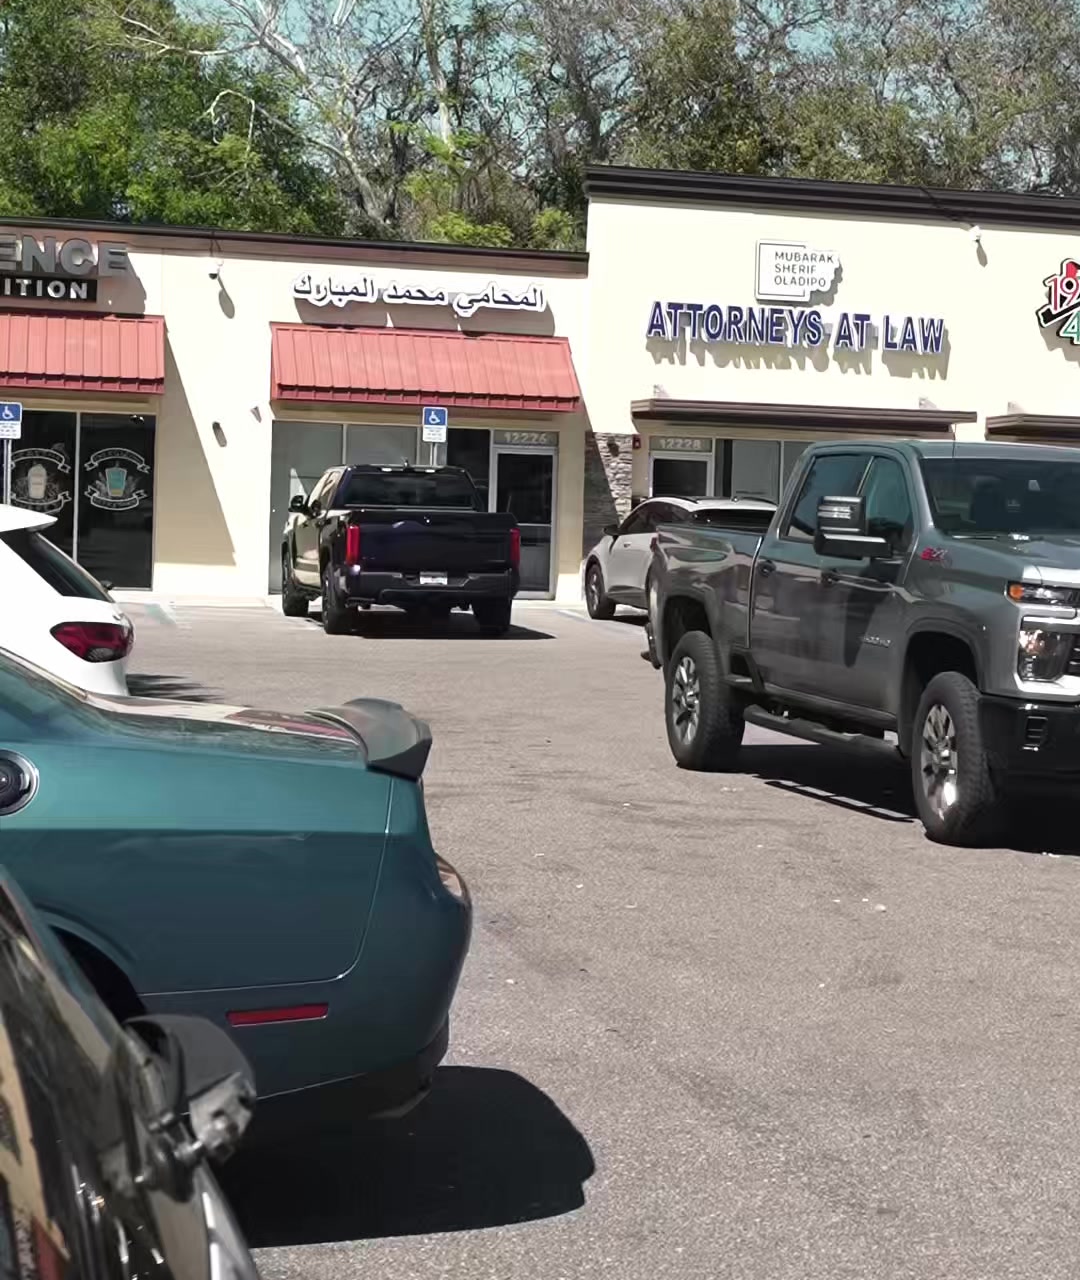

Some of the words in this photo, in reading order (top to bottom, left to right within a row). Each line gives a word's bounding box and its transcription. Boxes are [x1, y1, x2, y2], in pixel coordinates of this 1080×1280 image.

[774, 251, 834, 264] MUBARAK
[774, 263, 817, 275] SHERIF
[774, 275, 827, 288] OLADIPO
[294, 275, 375, 303] المبارك
[387, 283, 445, 302] محمد
[457, 285, 543, 313] المحامي
[647, 301, 822, 346] ATTORNEYS
[835, 313, 871, 348] AT
[883, 315, 945, 354] LAW
[503, 431, 547, 444] 12226
[659, 438, 701, 450] 12228
